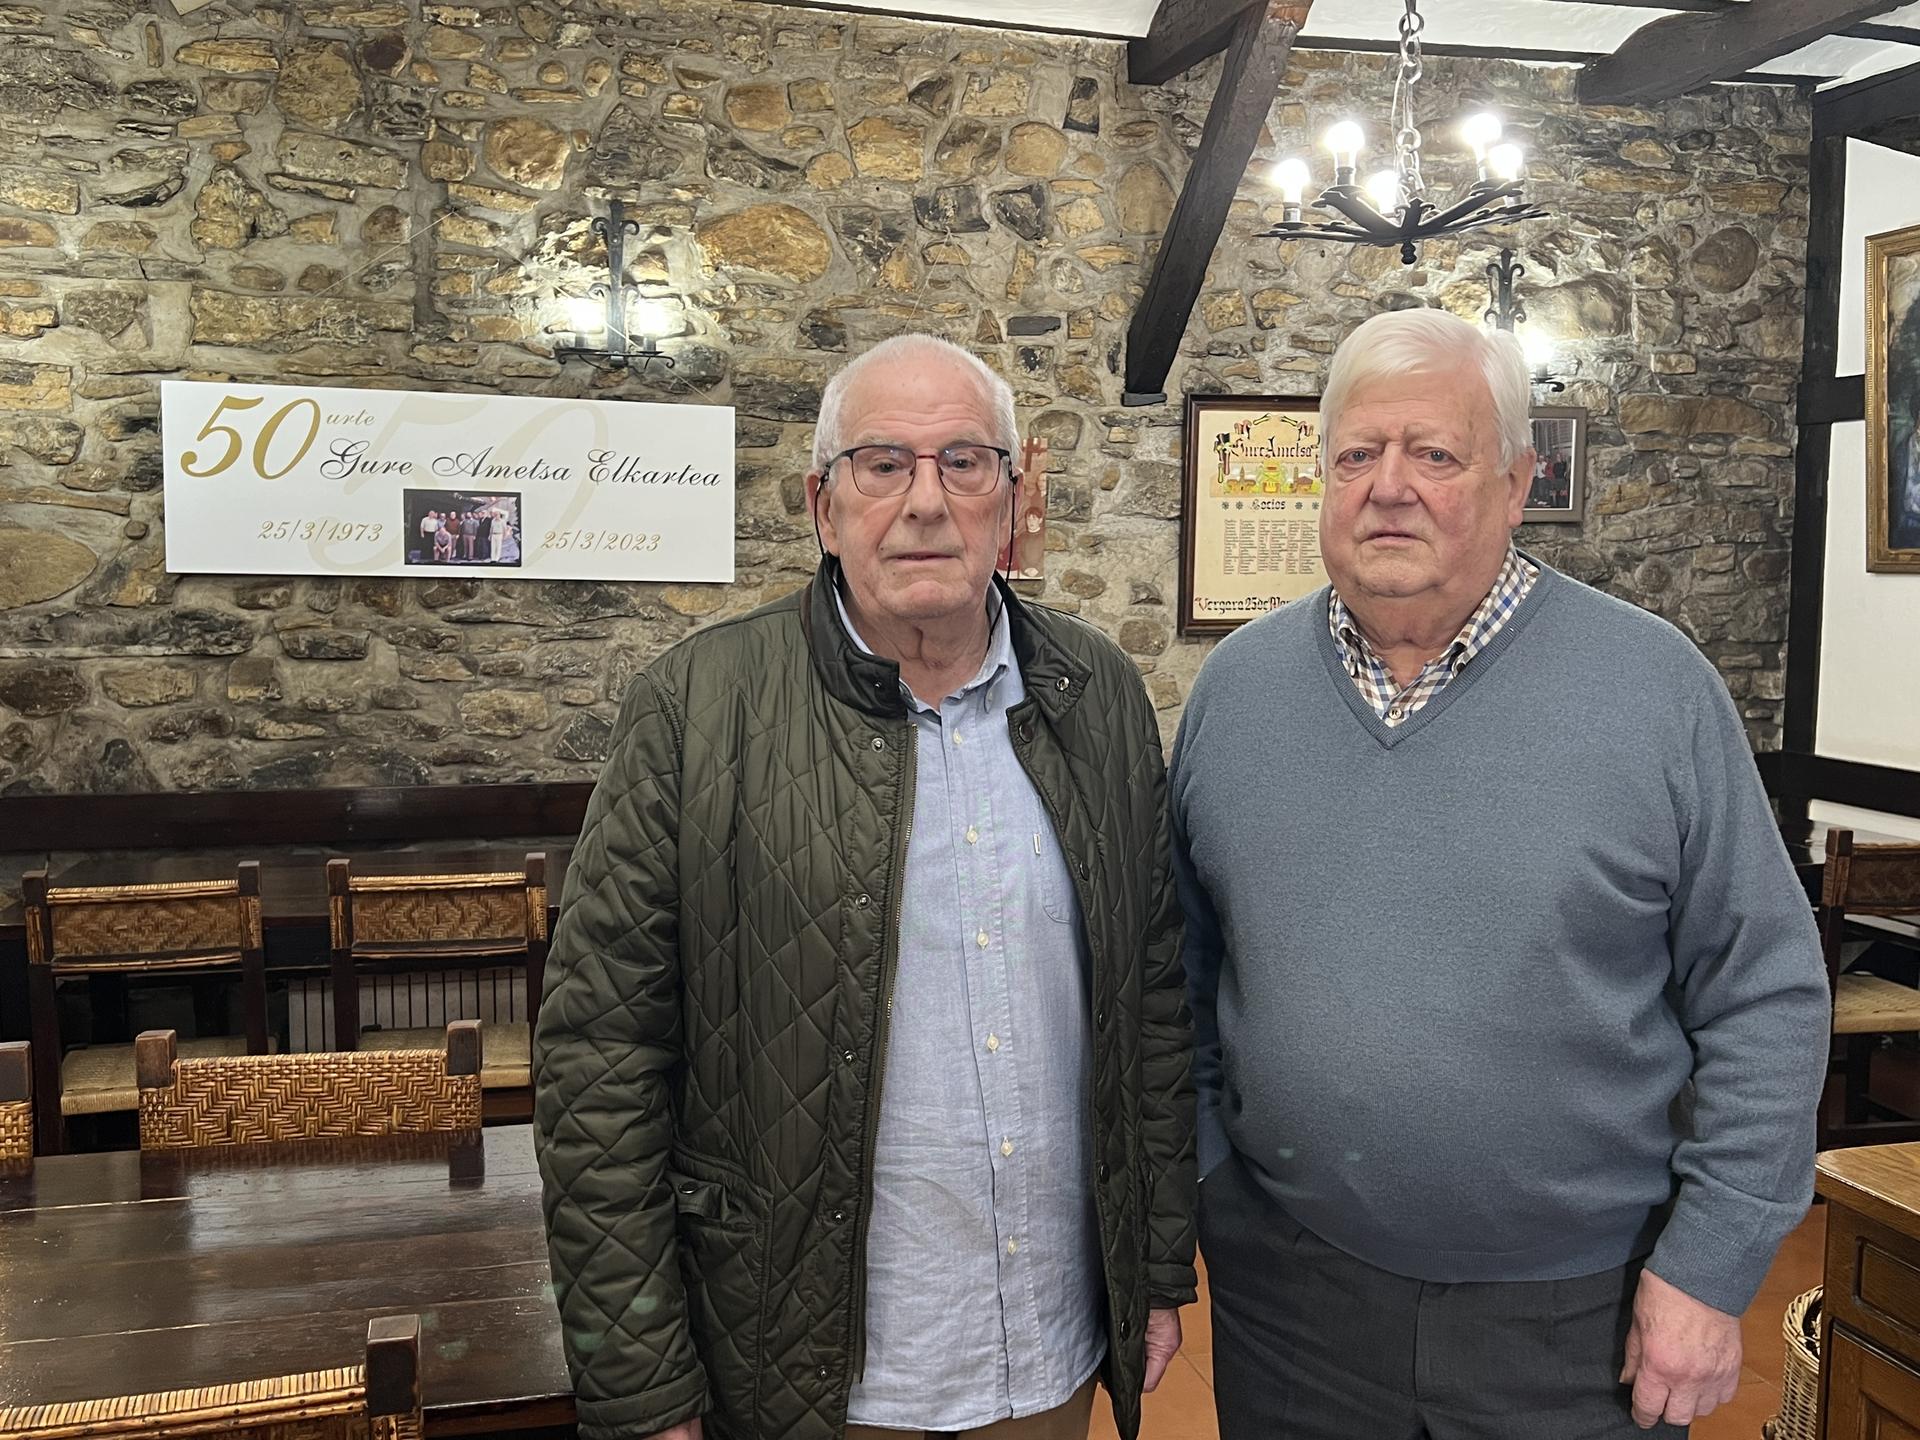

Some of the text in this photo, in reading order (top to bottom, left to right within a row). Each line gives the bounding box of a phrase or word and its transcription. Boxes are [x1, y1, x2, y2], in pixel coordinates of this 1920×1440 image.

[180, 395, 376, 480] 50 urte
[320, 438, 721, 487] Gure Ametsa Elkartea
[257, 519, 384, 542] 25/3/1973
[540, 529, 662, 552] 25/3/2023
[1194, 597, 1244, 614] Vergara
